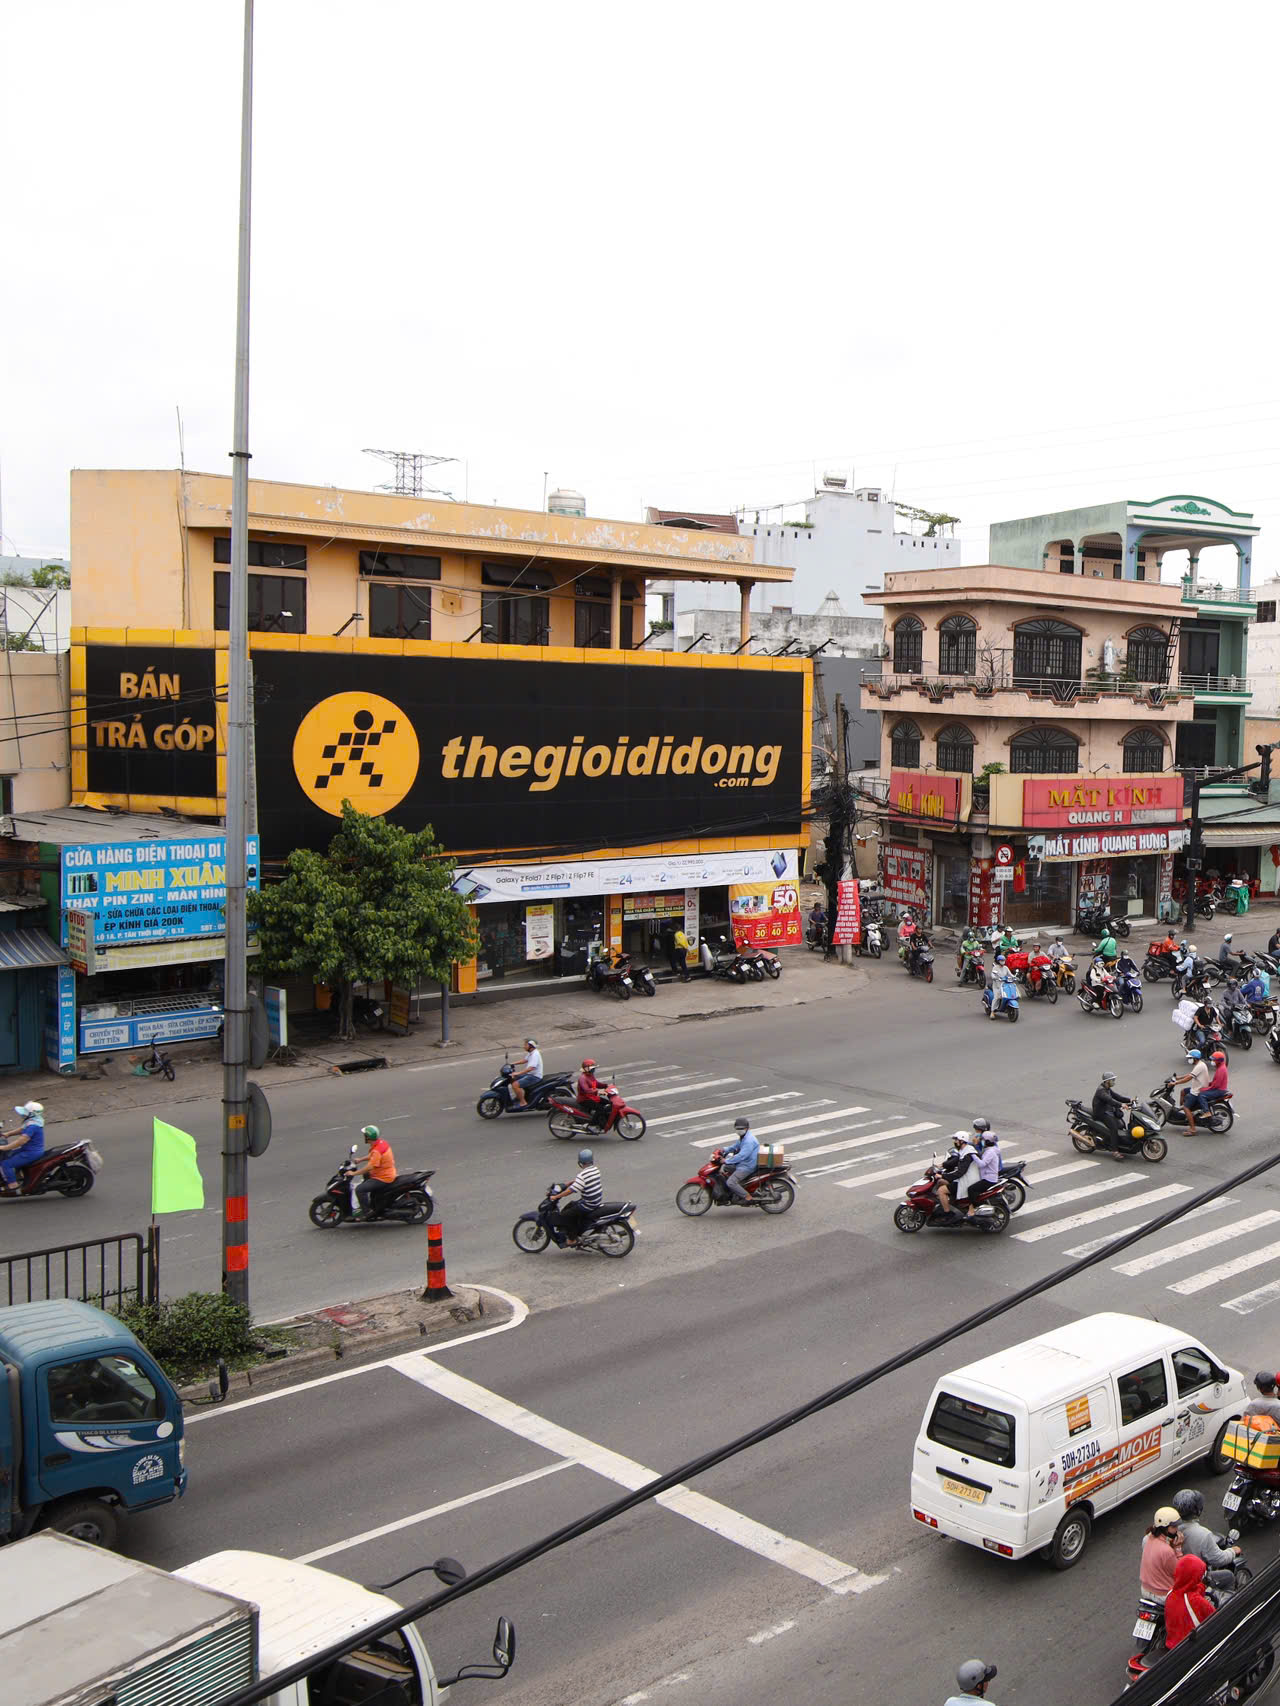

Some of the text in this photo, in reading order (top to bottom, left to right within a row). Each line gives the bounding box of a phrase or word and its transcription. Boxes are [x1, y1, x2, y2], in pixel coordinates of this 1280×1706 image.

[120, 666, 180, 700] BÁN
[91, 714, 215, 751] TRẢ GÓP
[442, 736, 781, 792] thegioididong
[714, 777, 748, 787] .com
[1048, 783, 1101, 808] MẮT
[1068, 811, 1110, 824] QUANG
[1046, 833, 1167, 857] MẮT KÍNH QUANG HƯNG
[66, 846, 93, 867] CỬA
[96, 846, 134, 865] HÀNG
[136, 844, 167, 865] ĐIỆN
[169, 843, 206, 862] THOẠI
[208, 843, 221, 858] DI
[105, 869, 165, 892] MINH
[496, 875, 519, 887] Galaxy
[526, 873, 542, 881] Fold7
[552, 871, 565, 880] Flip7
[574, 870, 588, 879] Flip7
[588, 871, 595, 879] FE
[619, 873, 633, 885] 24
[661, 873, 667, 883] 2
[702, 869, 708, 880] 2
[65, 897, 99, 908] THAY
[103, 894, 127, 906] PIN
[131, 893, 155, 905] ZIN
[167, 888, 198, 901] MÀN
[773, 890, 797, 907] 50
[146, 904, 160, 915] CÁC
[104, 918, 116, 931] ÉP
[120, 918, 141, 930] KÍNH
[144, 915, 159, 927] GIÁ
[161, 917, 184, 927] 200K
[1061, 1440, 1101, 1471] 50H-273.04
